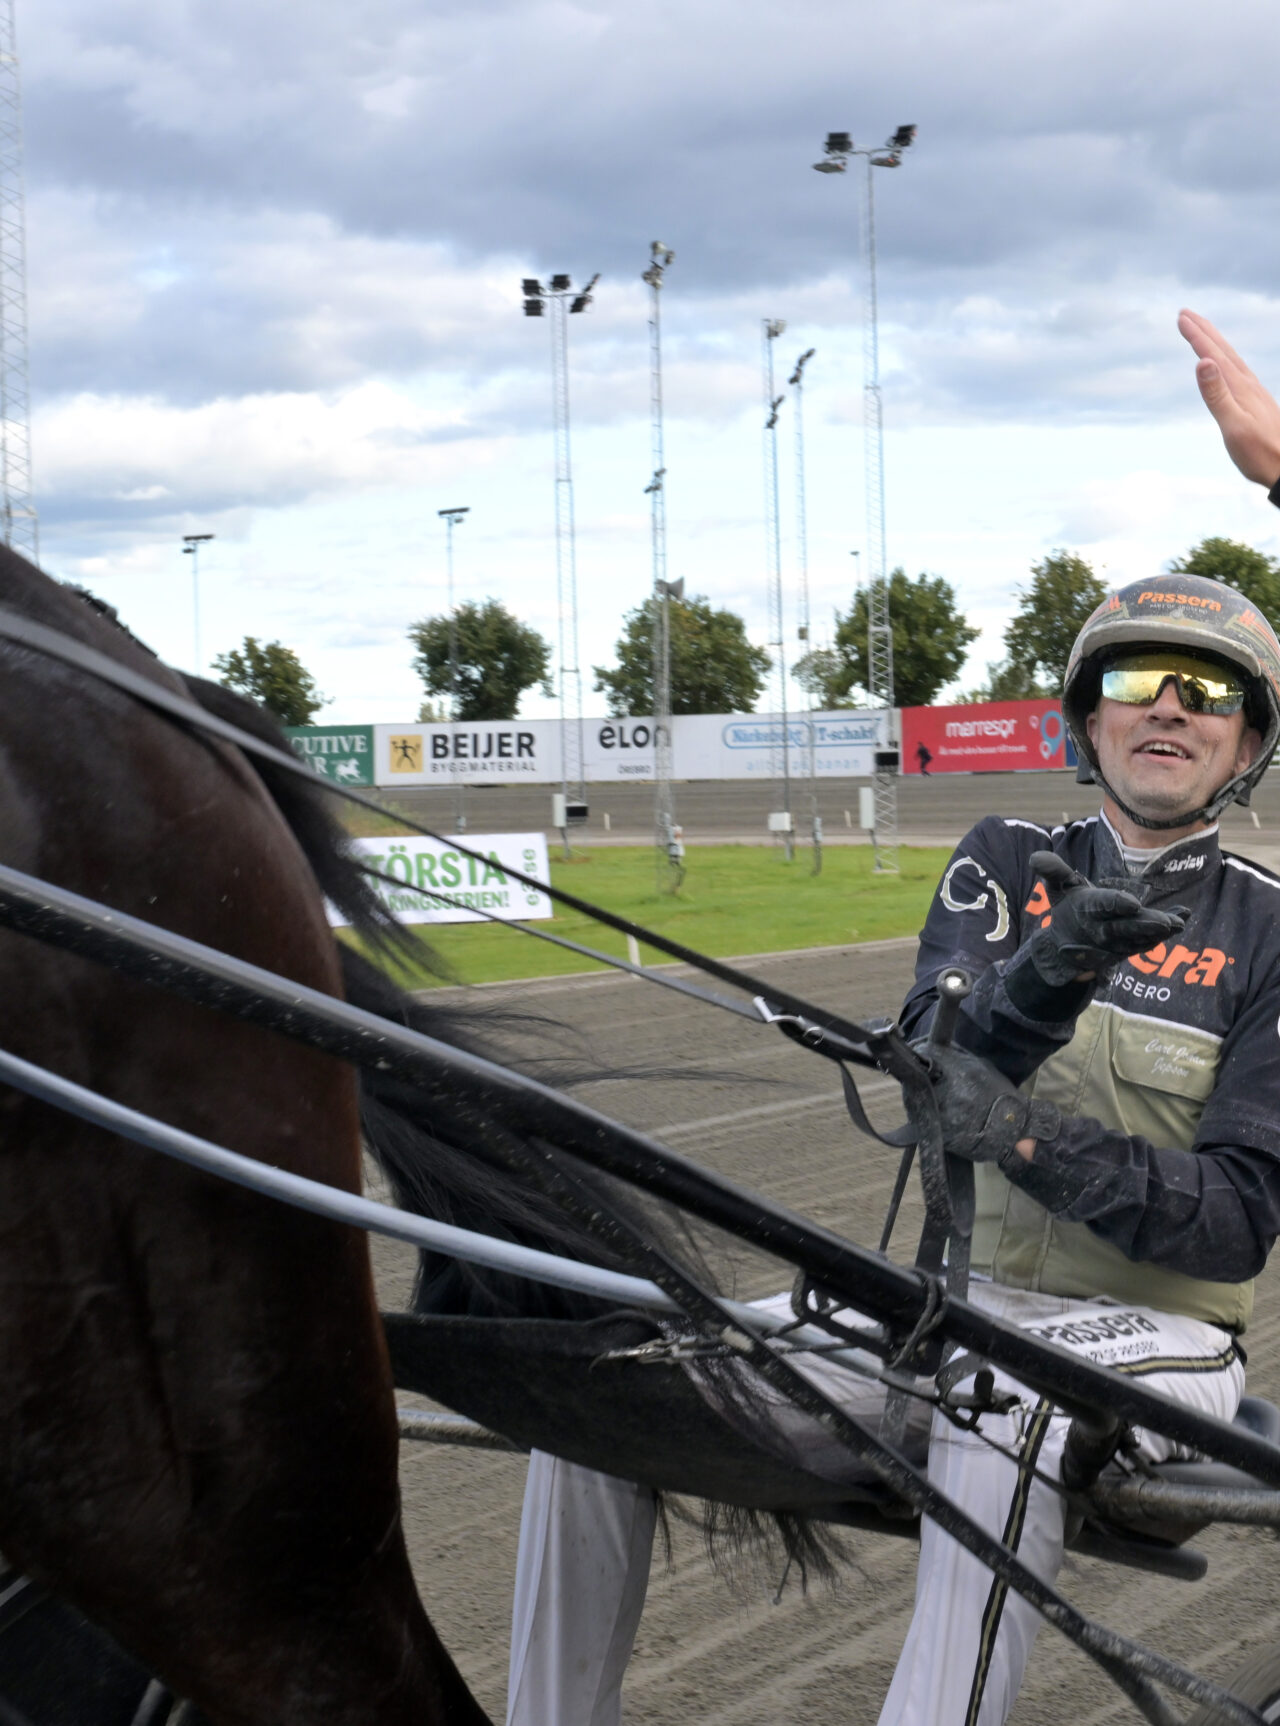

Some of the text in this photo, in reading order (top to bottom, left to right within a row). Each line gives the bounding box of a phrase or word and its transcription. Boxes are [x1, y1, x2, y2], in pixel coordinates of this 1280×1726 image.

[1137, 591, 1222, 613] Passera
[291, 734, 368, 754] CUTIVE
[431, 731, 536, 759] BEIJER
[363, 844, 508, 890] TÖRSTA
[382, 890, 511, 913] RINGSSERIEN!
[1111, 971, 1171, 1002] OSERO
